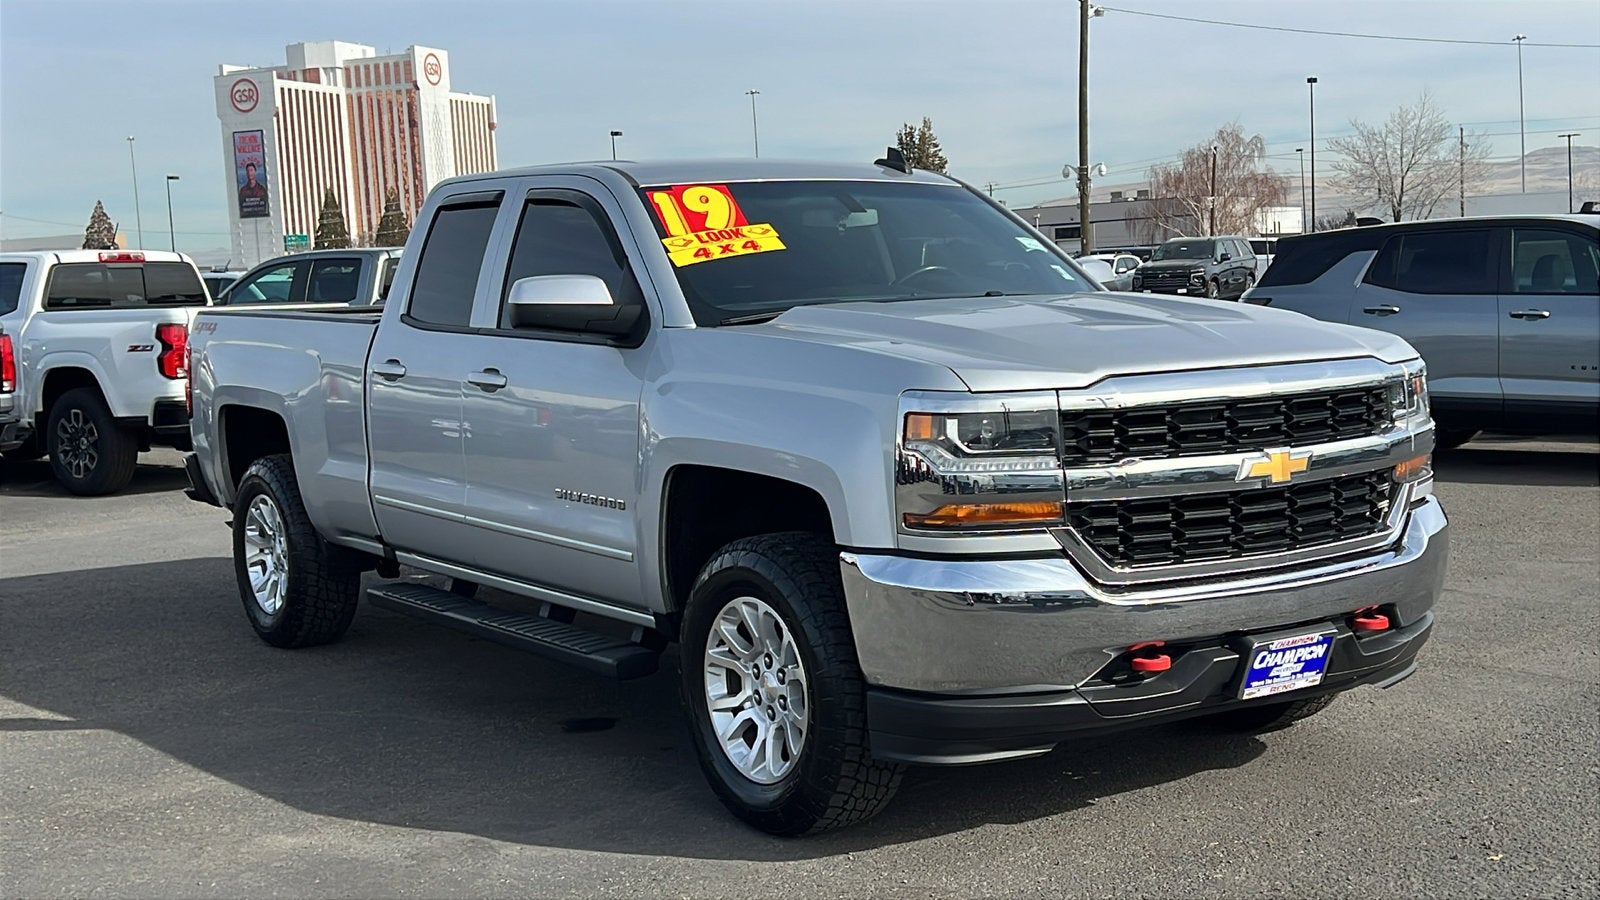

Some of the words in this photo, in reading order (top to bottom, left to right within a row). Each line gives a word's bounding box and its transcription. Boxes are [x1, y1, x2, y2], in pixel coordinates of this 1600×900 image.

[234, 88, 256, 104] GSR
[652, 186, 736, 237] 19
[694, 227, 747, 244] LOOK
[554, 488, 626, 510] SILVERADO
[1276, 636, 1316, 648] CHAMPION
[1253, 644, 1328, 669] CHAMPION
[1270, 682, 1296, 692] RENO
